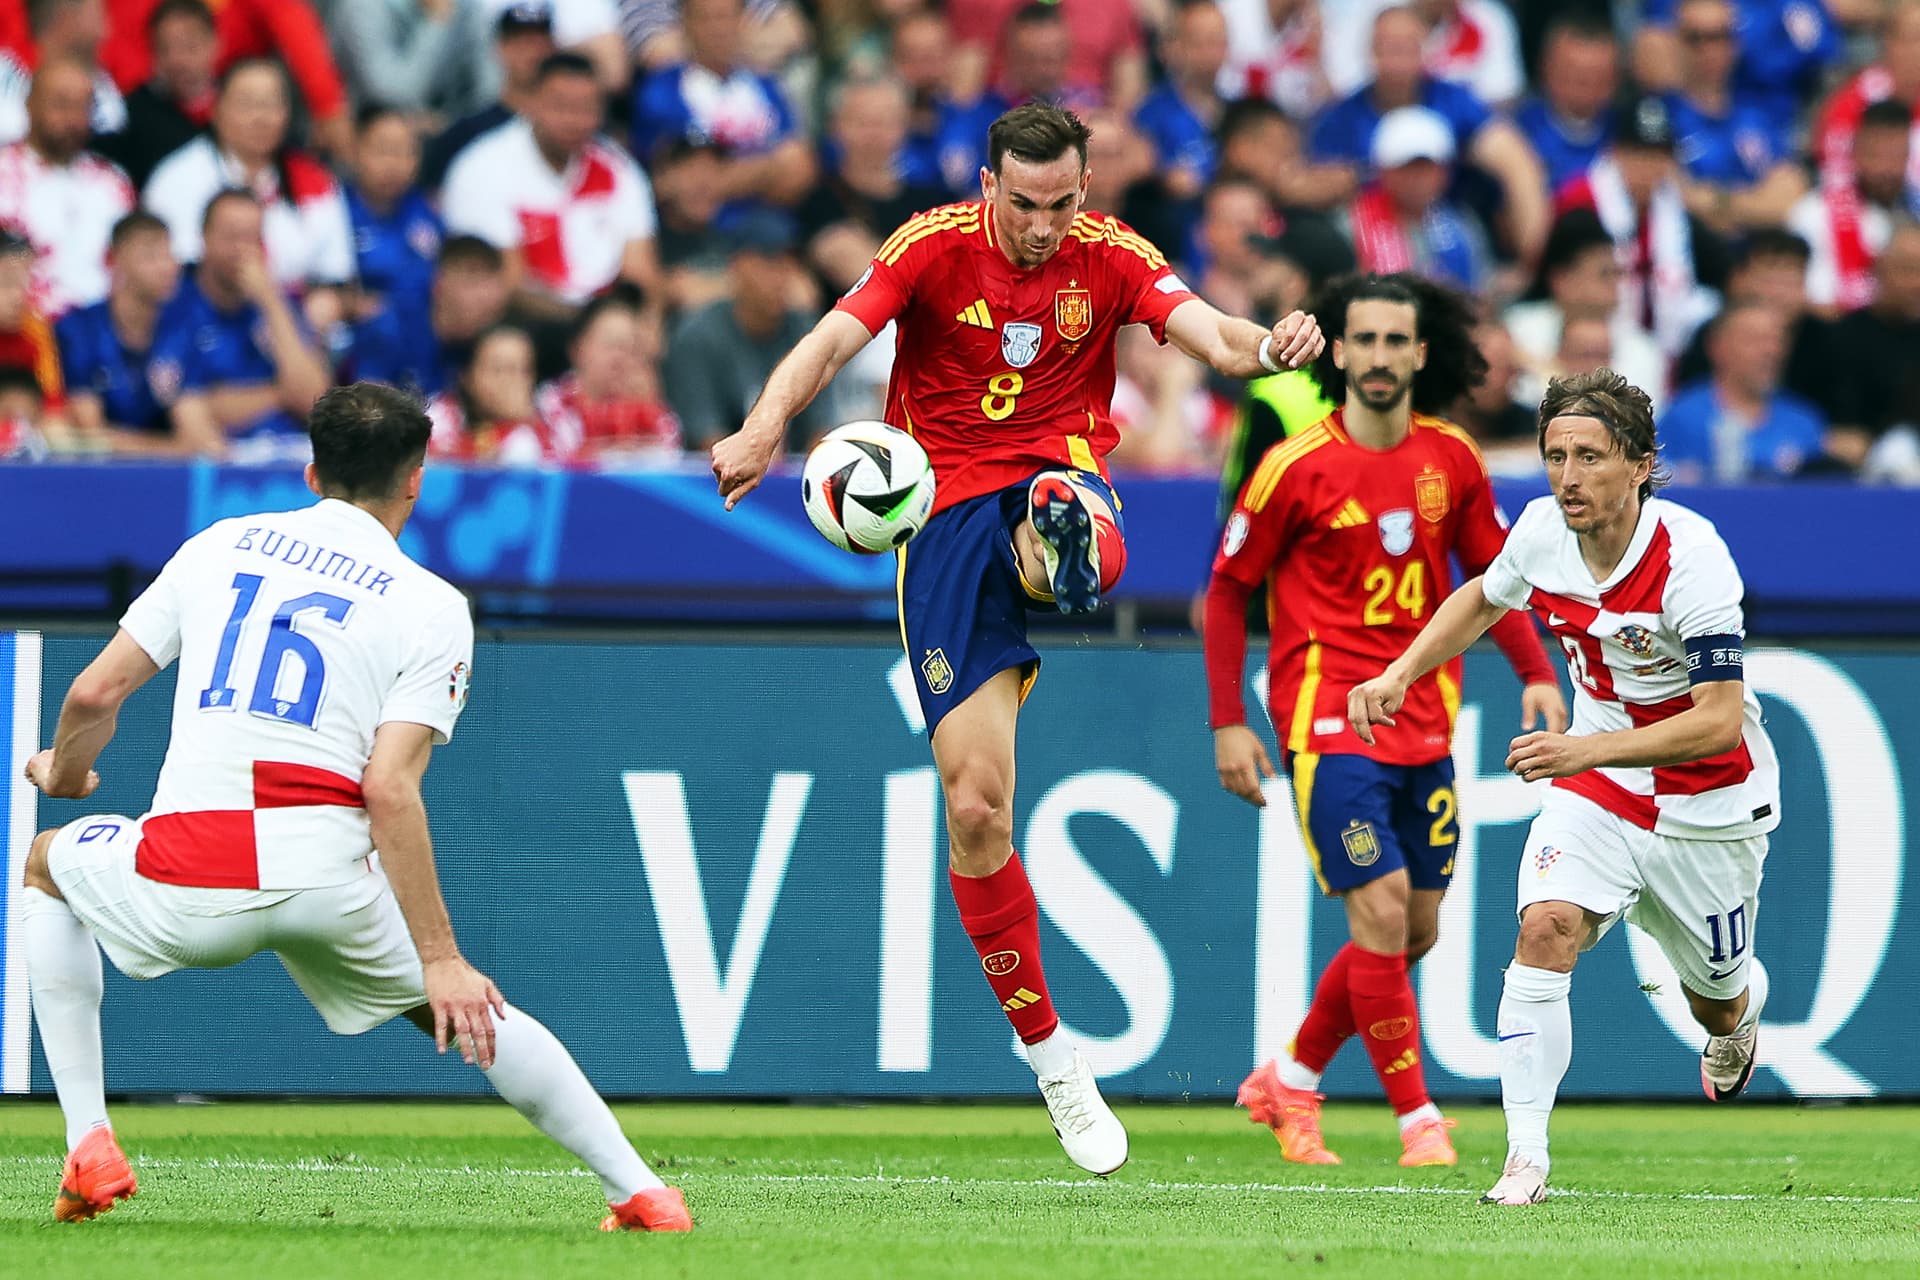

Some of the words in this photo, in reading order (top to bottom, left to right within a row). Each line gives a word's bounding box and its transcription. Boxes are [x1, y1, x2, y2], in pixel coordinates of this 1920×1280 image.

[981, 371, 1024, 421] 8
[234, 528, 394, 596] BUDIMIR
[1363, 560, 1426, 627] 24
[199, 571, 356, 731] 16
[1705, 903, 1746, 963] 10
